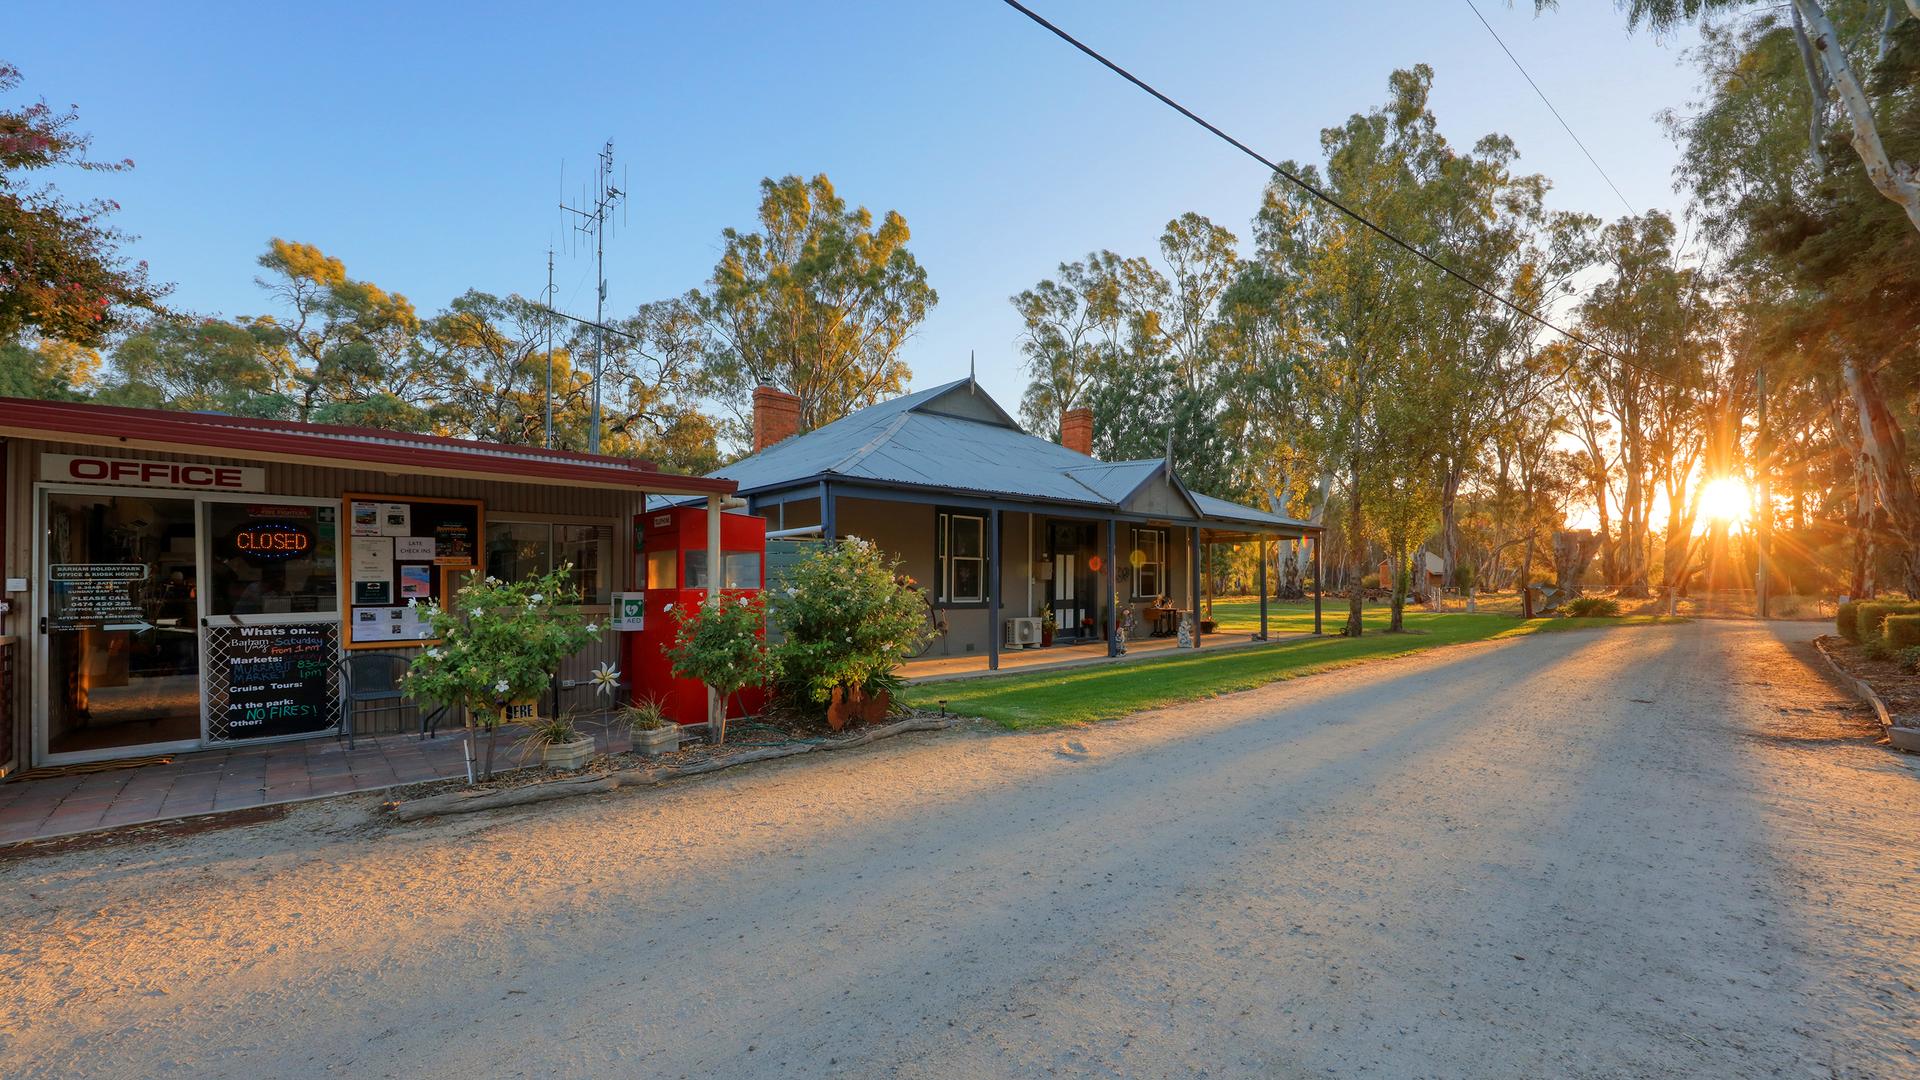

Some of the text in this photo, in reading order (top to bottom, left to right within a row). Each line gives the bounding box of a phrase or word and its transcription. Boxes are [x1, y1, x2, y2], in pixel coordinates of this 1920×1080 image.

[69, 459, 242, 487] OFFICE
[237, 533, 307, 550] CLOSED
[240, 627, 320, 637] Whats on...
[231, 639, 269, 647] Barham
[274, 637, 323, 647] Saturday
[271, 646, 292, 655] From
[230, 656, 283, 665] Markets:
[233, 669, 322, 684] MARKET 1pm
[229, 682, 303, 693] Cruise Tours:
[229, 703, 243, 711] At
[266, 699, 294, 708] park:
[246, 707, 266, 720] NO
[229, 719, 264, 728] Other:
